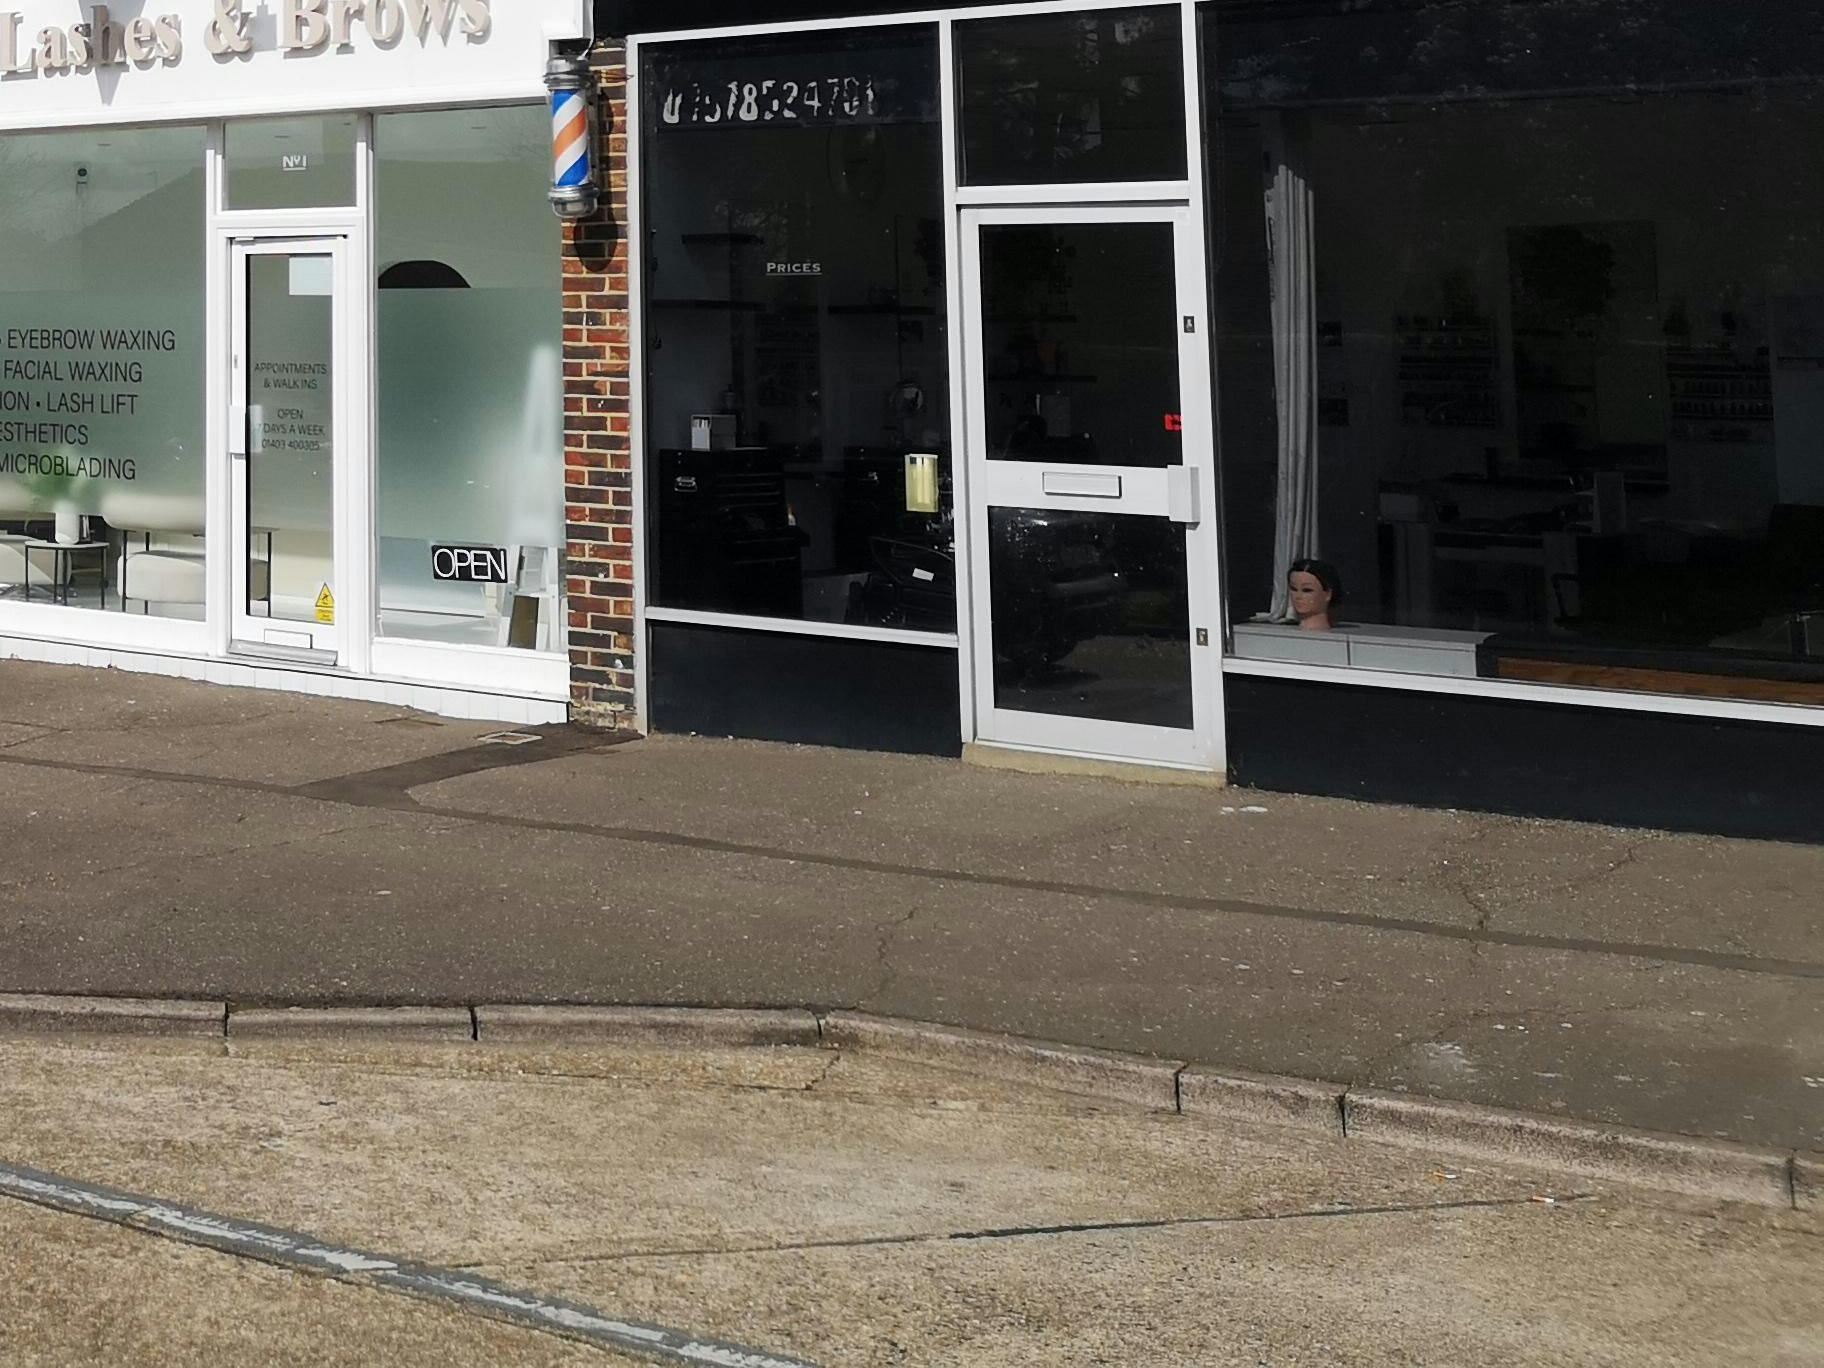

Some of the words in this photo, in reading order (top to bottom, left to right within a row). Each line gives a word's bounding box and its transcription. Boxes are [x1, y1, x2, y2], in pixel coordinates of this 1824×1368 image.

[7, 329, 95, 349] EYEBROW
[100, 330, 176, 351] WAXING
[3, 360, 64, 381] FACIAL
[68, 361, 143, 383] WAXING
[254, 362, 328, 375] APPOINTMENTS
[47, 392, 94, 413] LASH
[101, 393, 138, 415] LIFT
[277, 408, 304, 420] OPEN
[263, 422, 287, 434] DAYS
[289, 424, 296, 434] A
[299, 424, 326, 436] WEEK
[433, 547, 507, 581] OPEN
